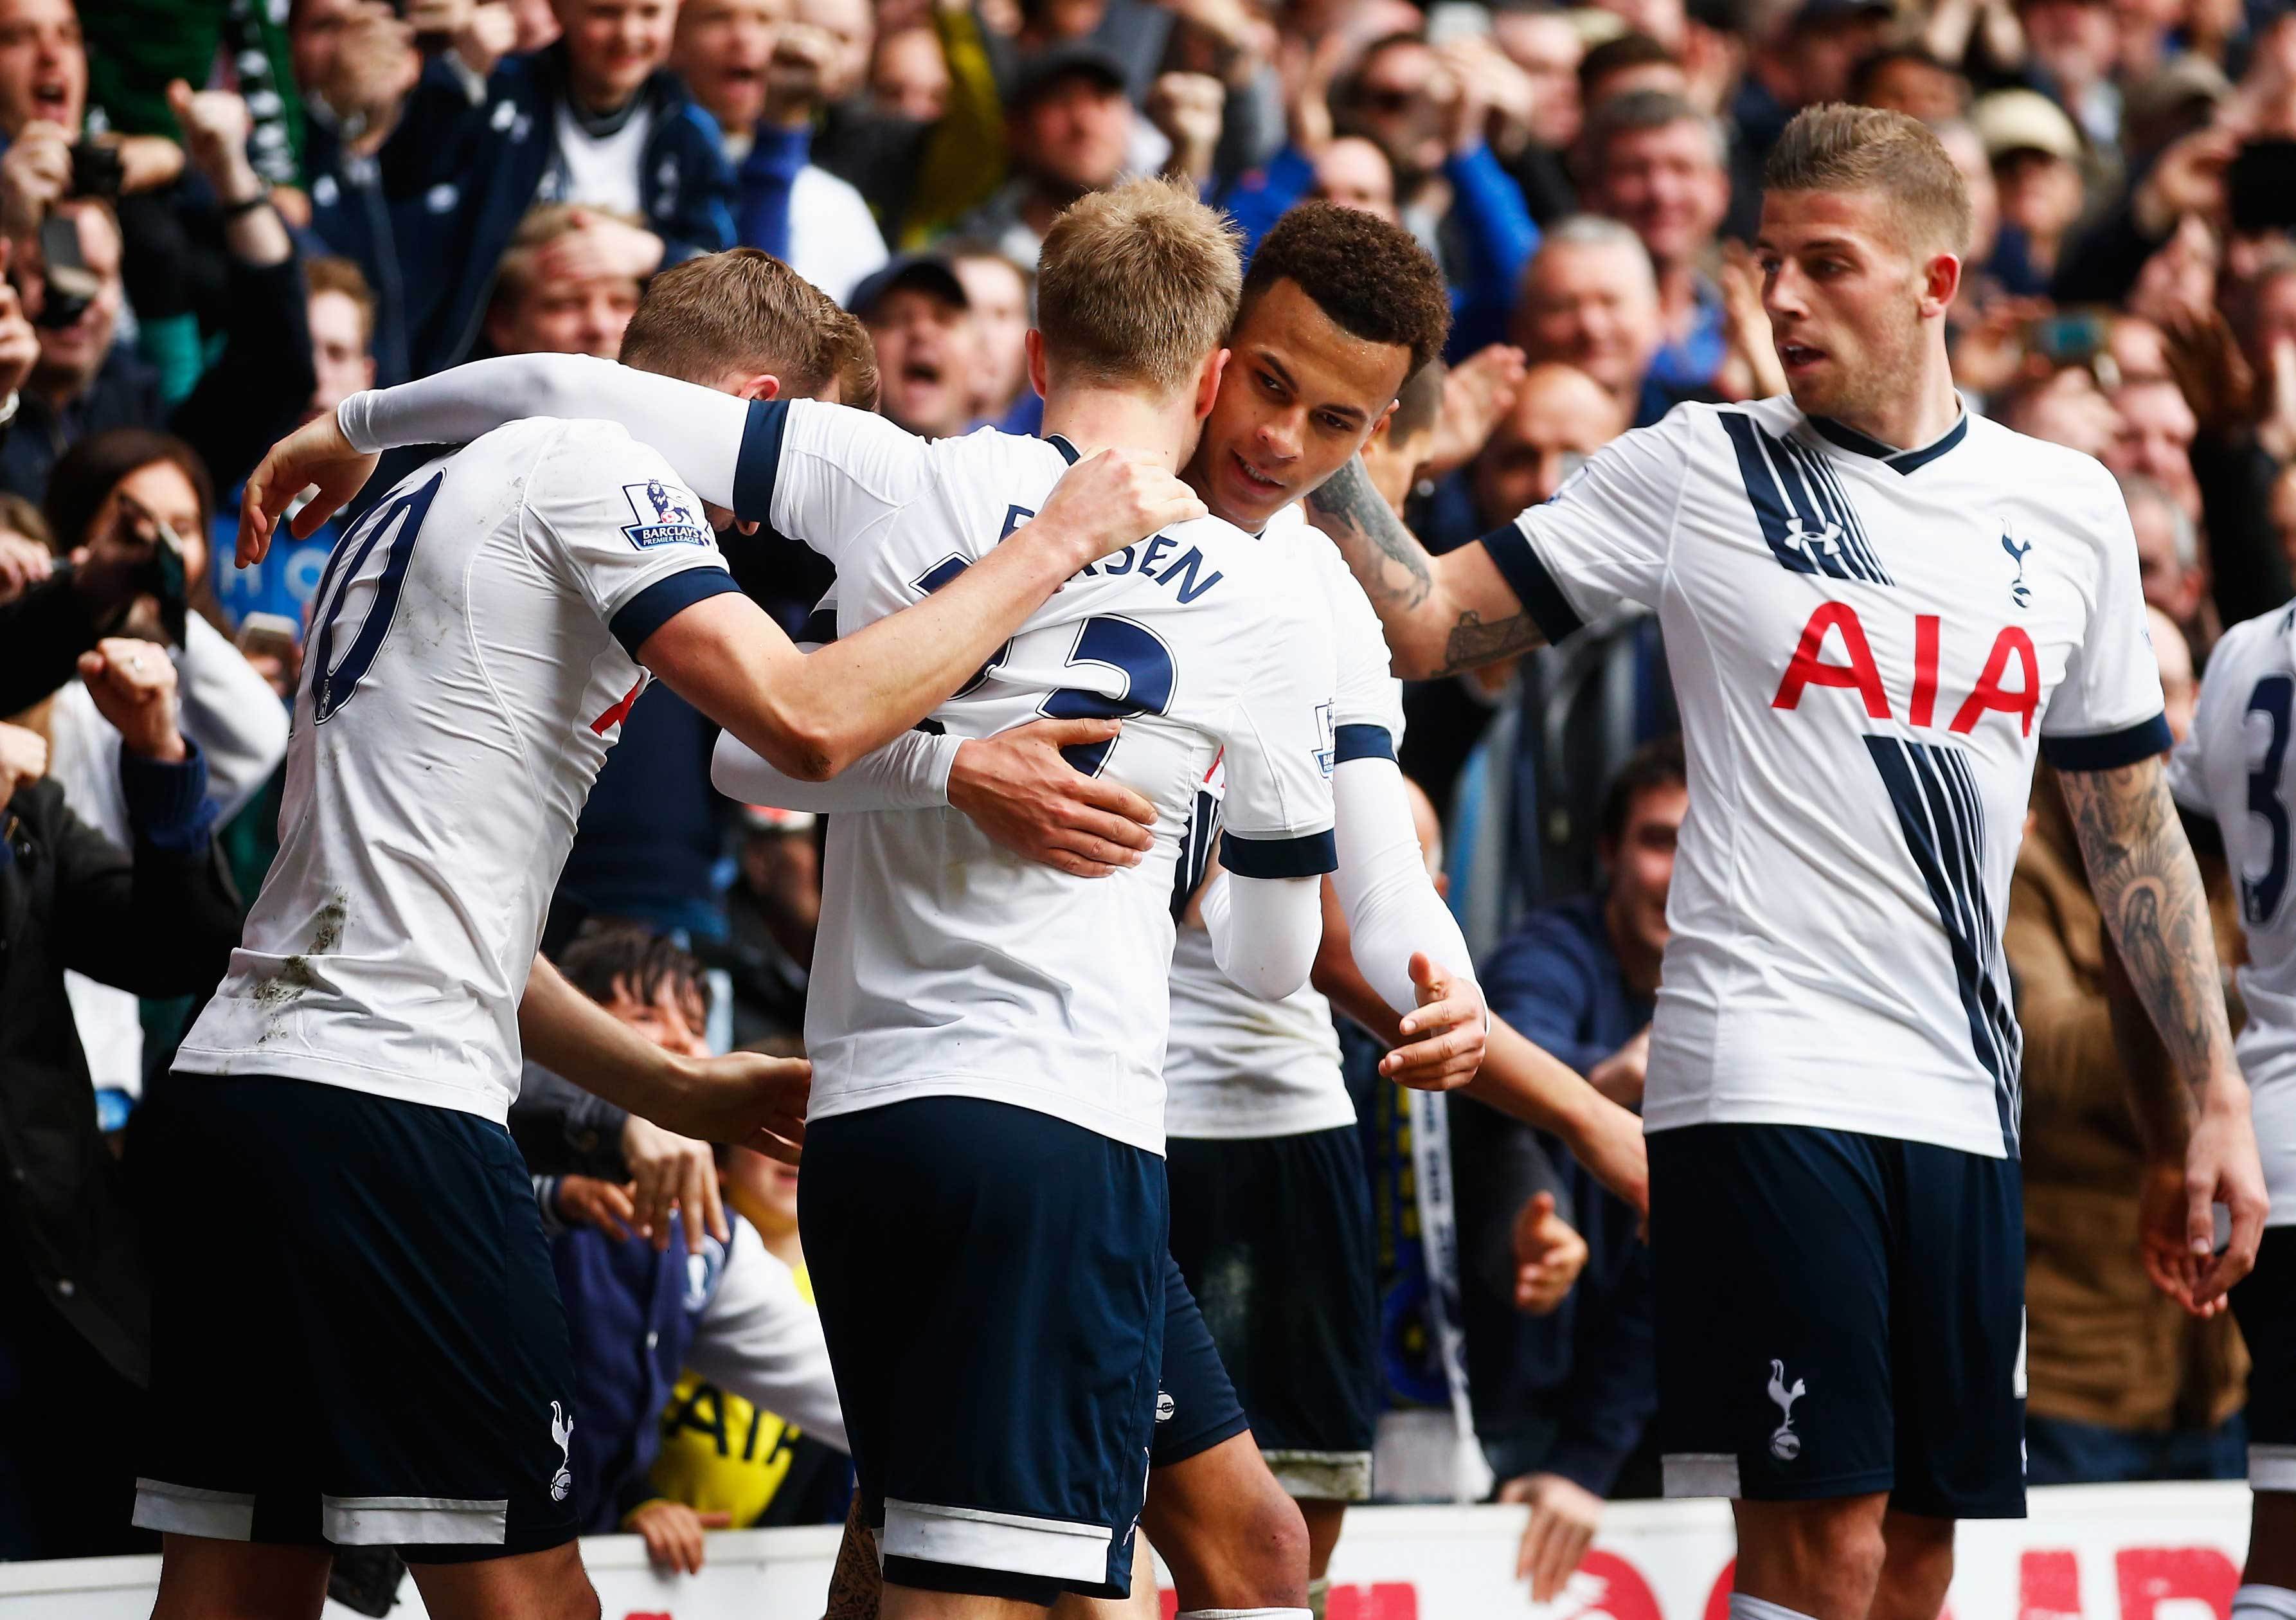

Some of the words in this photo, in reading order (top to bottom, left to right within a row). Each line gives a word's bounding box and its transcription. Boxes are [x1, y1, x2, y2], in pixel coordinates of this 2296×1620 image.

[642, 526, 699, 539] BARCLAYS
[643, 536, 674, 546] PREMIER
[676, 536, 700, 544] LEAGUE
[998, 504, 1224, 604] ESEN
[1771, 600, 2040, 739] AIA
